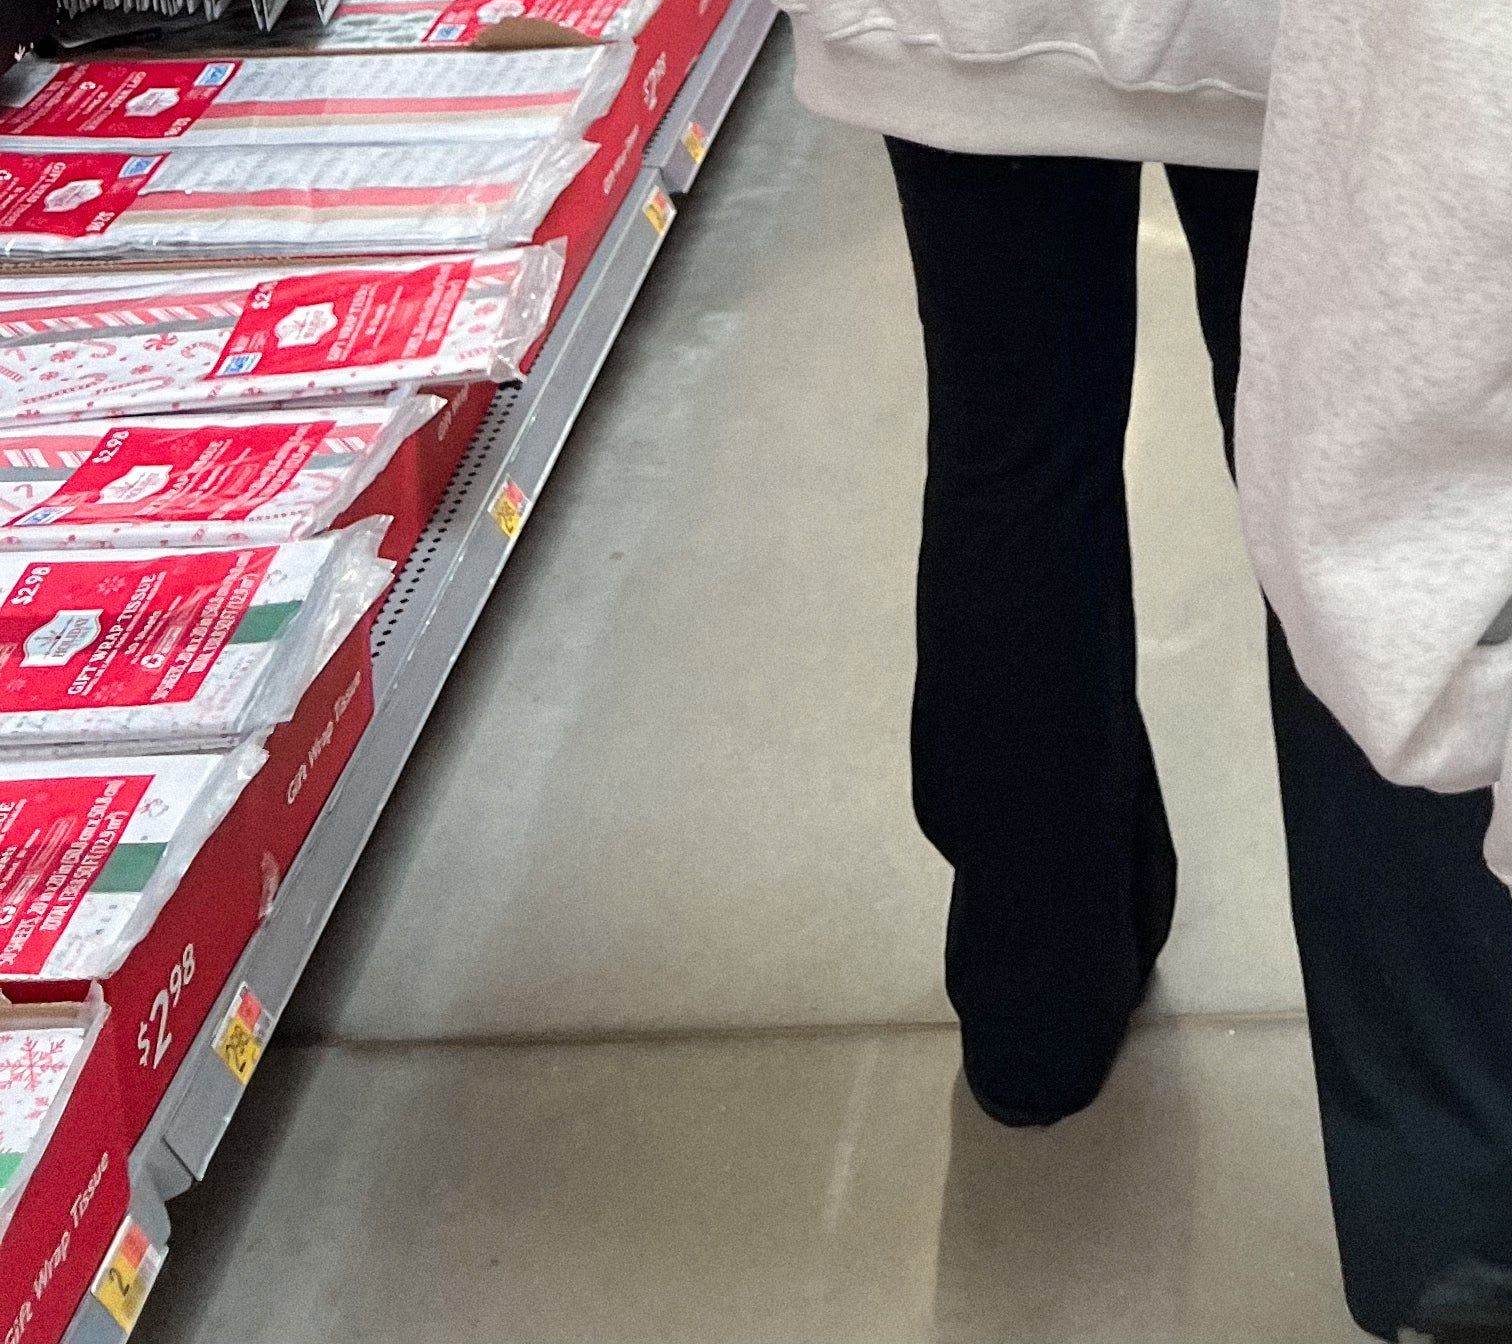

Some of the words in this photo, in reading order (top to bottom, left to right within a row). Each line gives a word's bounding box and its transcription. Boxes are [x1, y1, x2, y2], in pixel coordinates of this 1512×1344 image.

[92, 429, 130, 464] $2.98
[11, 565, 51, 607] $2.98
[67, 660, 94, 696] GIFT
[90, 624, 123, 662] WRAP
[115, 572, 158, 625] TISSUE
[33, 1230, 71, 1300] Wrap
[70, 1151, 110, 1229] Tissue
